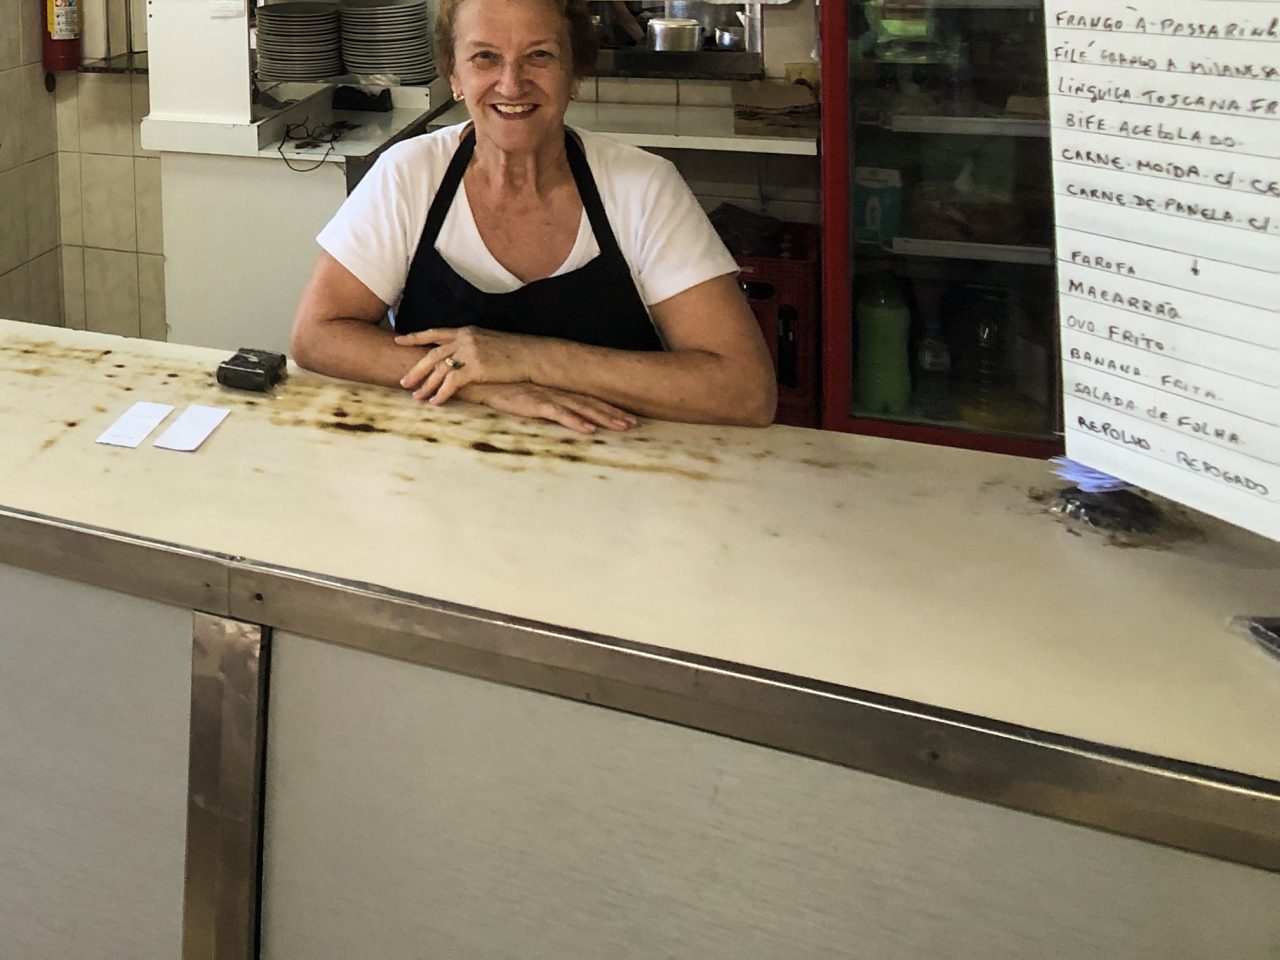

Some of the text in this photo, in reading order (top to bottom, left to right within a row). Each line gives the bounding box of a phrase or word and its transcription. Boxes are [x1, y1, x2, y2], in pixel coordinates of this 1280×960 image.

[1056, 10, 1123, 32] FRANGO
[1062, 148, 1125, 171] CARNE
[1066, 183, 1127, 208] CARNE
[1133, 194, 1158, 212] DE
[1164, 197, 1234, 222] PANELA
[1066, 315, 1095, 333] OVO
